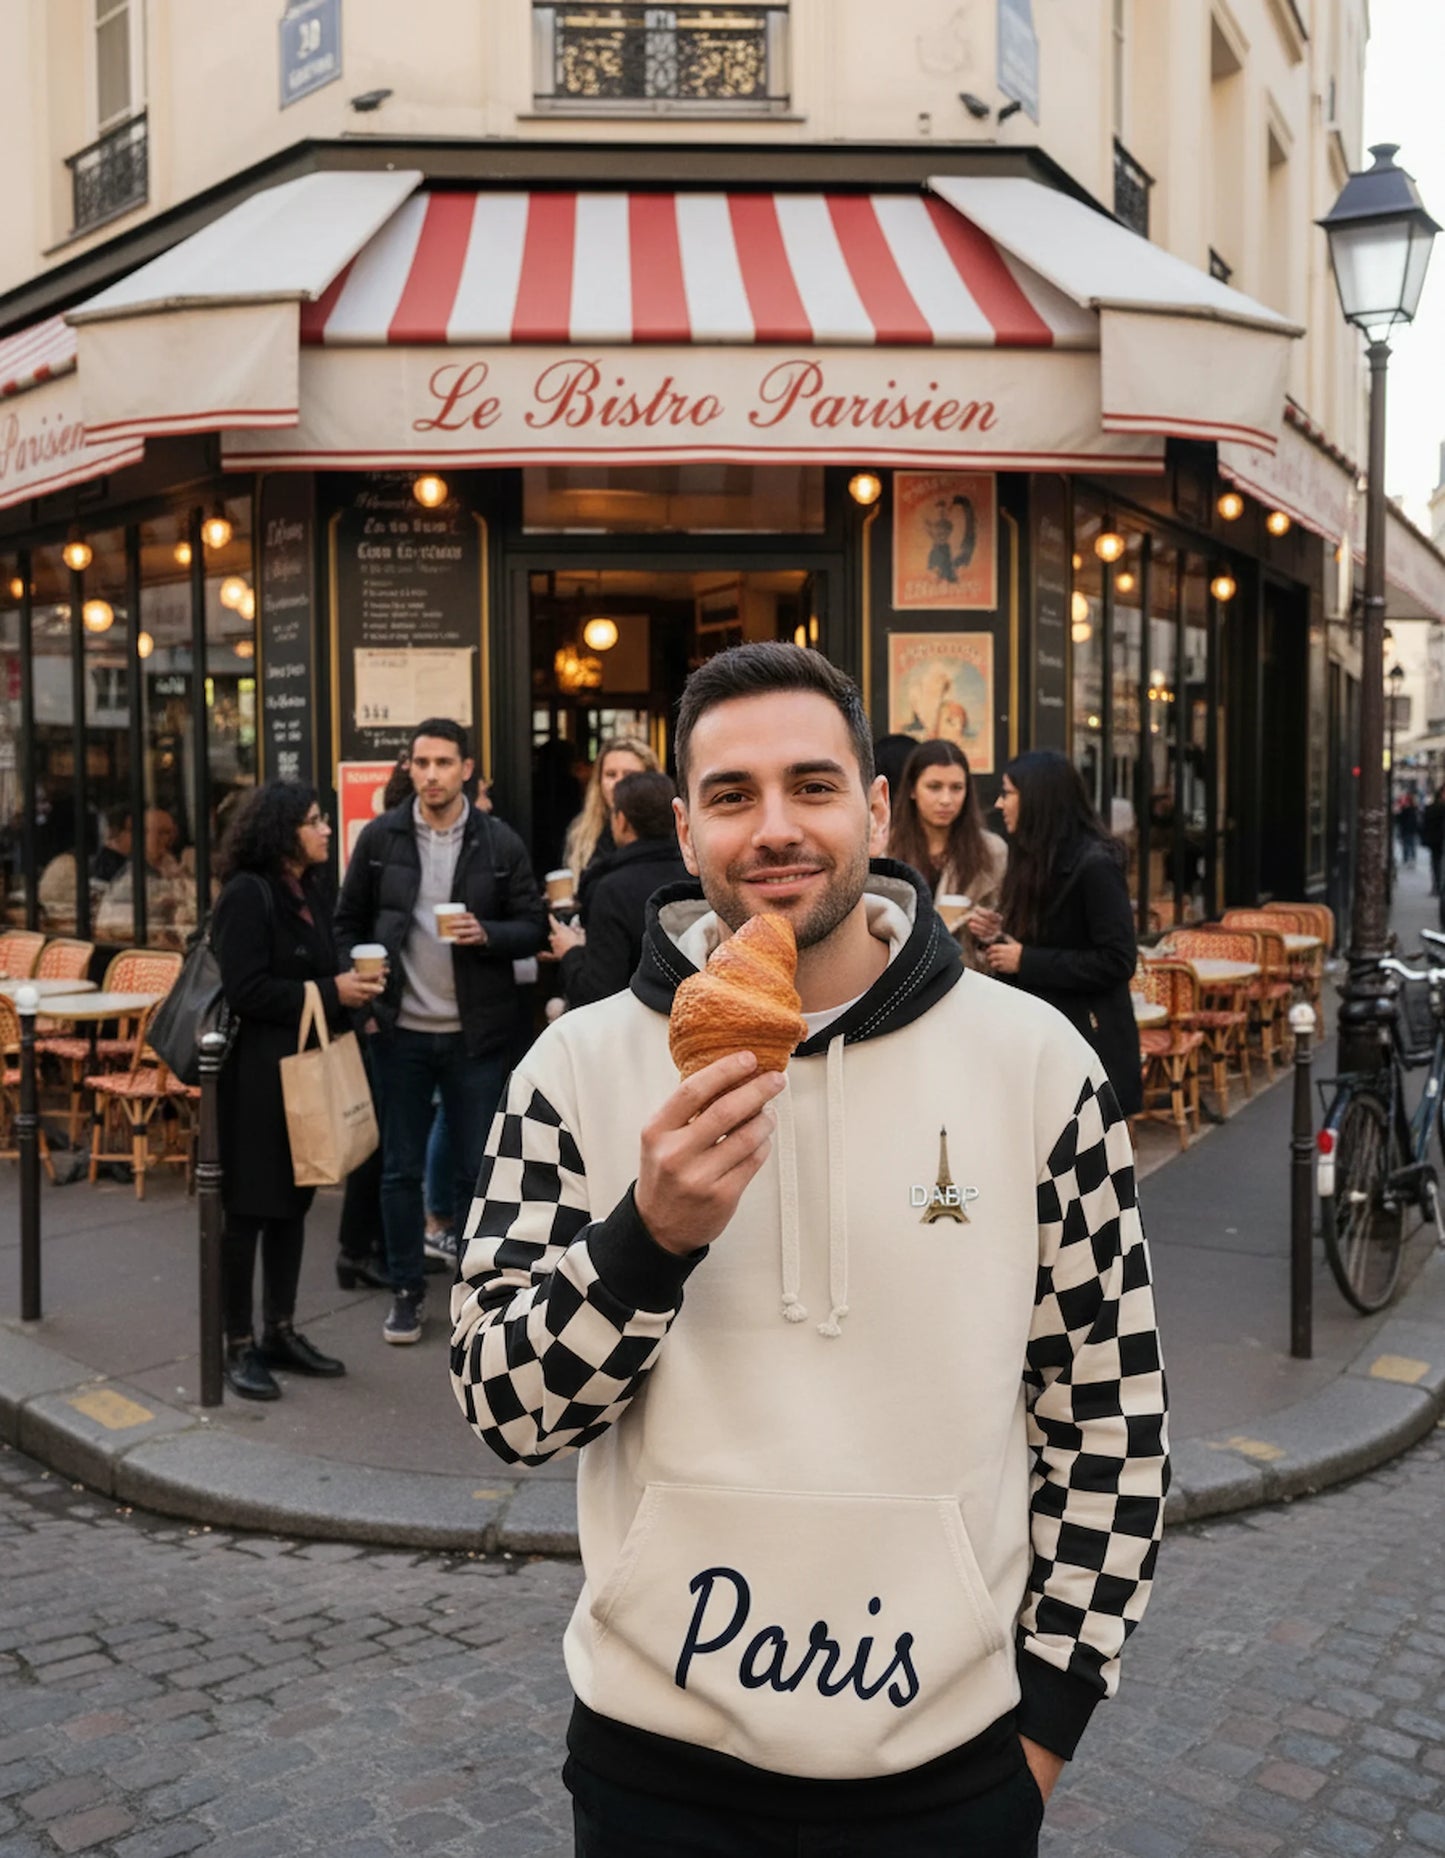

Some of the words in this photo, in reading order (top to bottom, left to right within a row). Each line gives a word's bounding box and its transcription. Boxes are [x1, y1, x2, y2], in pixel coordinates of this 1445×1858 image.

[412, 361, 502, 432] Le
[524, 358, 724, 429] Bistro
[748, 359, 998, 432] Parisien
[674, 1566, 920, 1708] Paris
